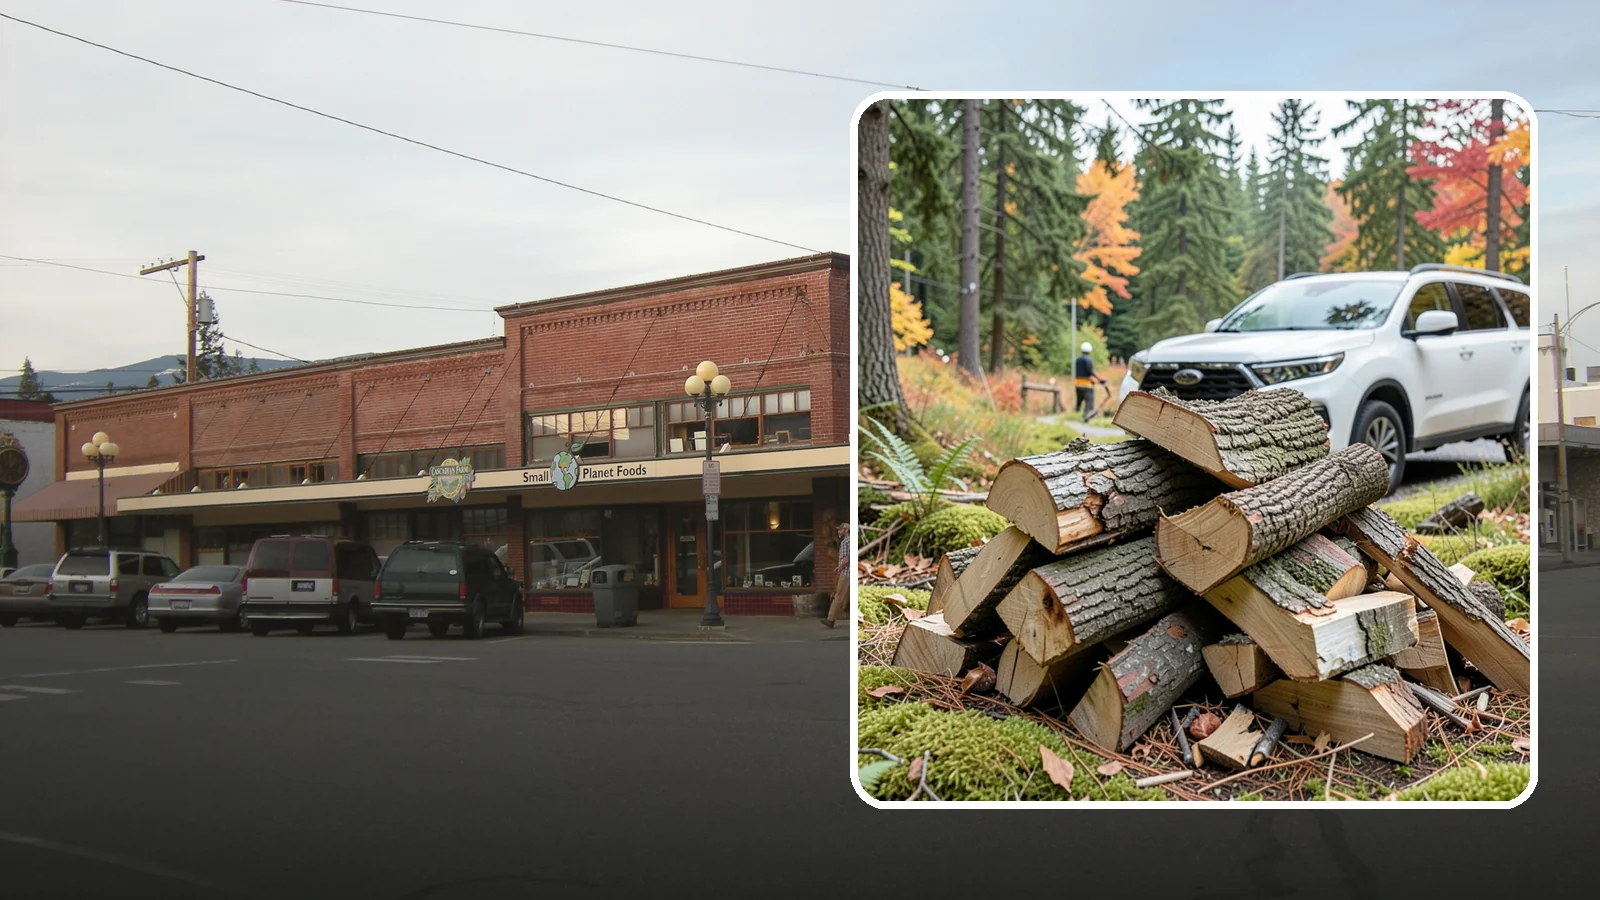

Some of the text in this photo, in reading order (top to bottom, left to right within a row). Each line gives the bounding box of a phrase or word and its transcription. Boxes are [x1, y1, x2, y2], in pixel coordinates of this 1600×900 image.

[523, 464, 646, 483] Small Planet Foods
